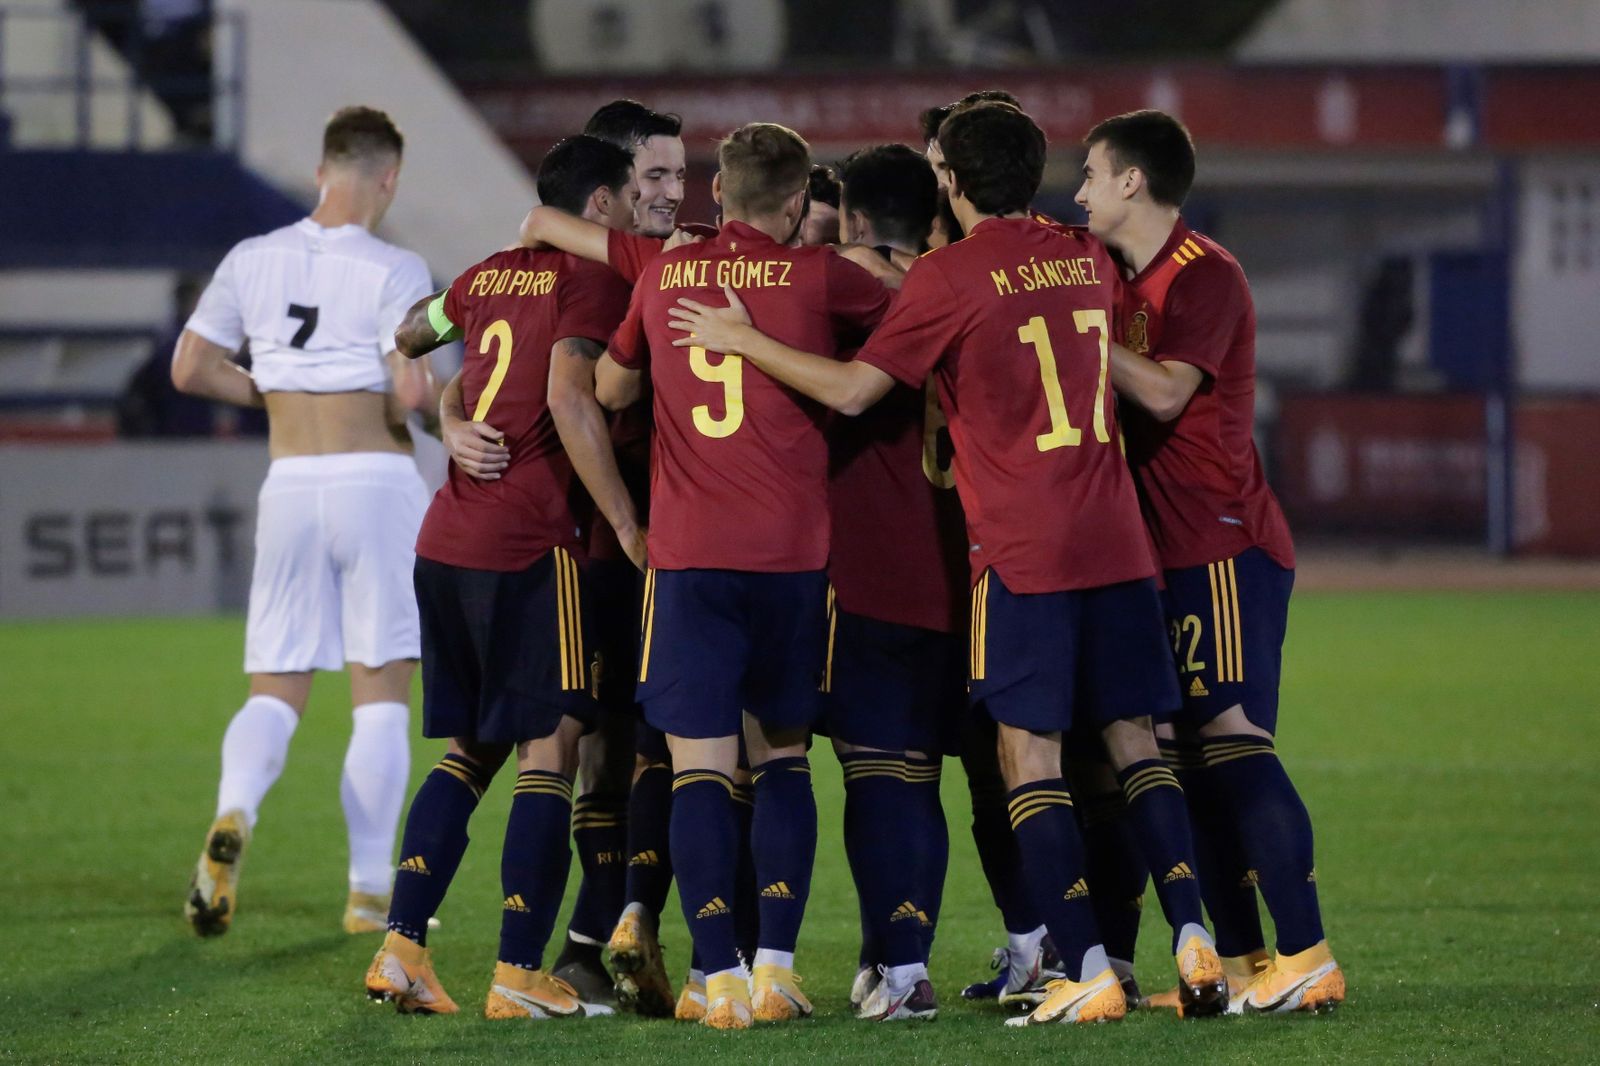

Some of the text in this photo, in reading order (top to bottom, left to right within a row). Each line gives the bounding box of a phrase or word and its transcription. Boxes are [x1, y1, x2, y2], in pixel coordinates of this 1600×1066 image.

[659, 255, 793, 291] DANI GÓMEZ
[990, 256, 1102, 296] M. SÁNCHEZ
[286, 303, 319, 350] 7
[472, 319, 513, 446] 2
[689, 331, 744, 439] 9
[1017, 309, 1111, 452] 17
[24, 510, 246, 580] SEAT
